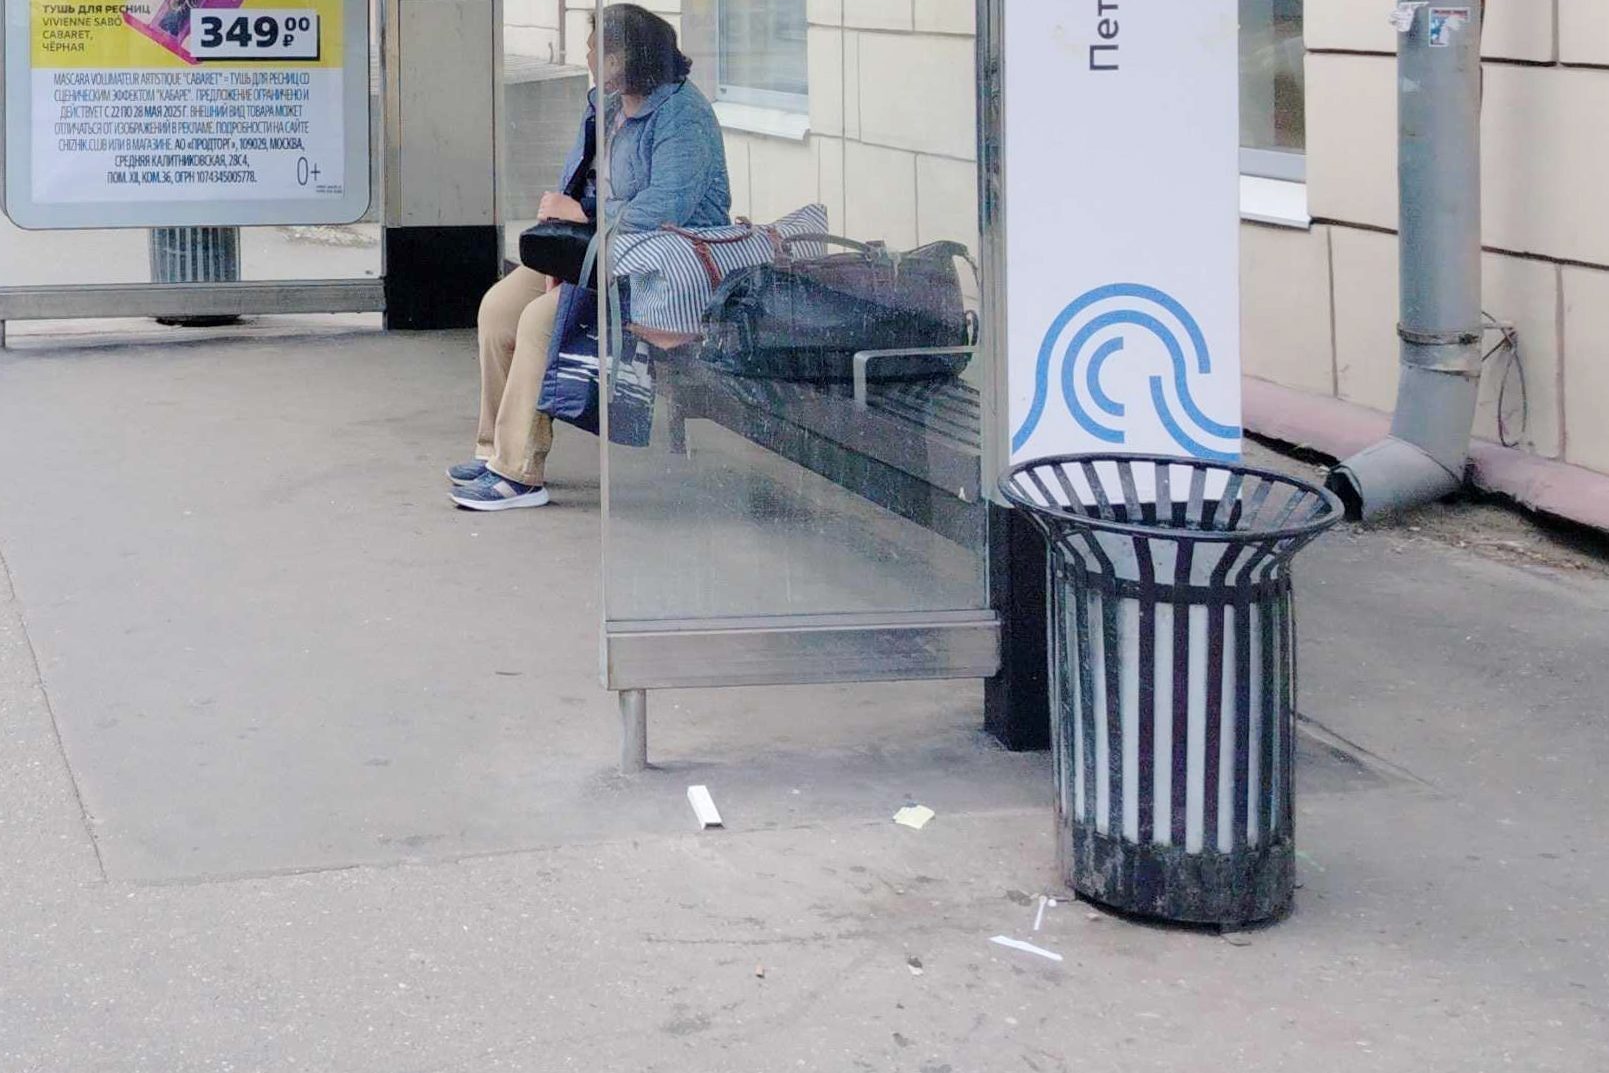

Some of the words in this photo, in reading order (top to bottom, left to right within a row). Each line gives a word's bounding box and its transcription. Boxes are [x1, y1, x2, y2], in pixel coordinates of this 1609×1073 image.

[42, 4, 75, 14] ТУШЬ
[77, 4, 103, 15] ДЛЯ
[105, 4, 151, 15] РЕСНИЦ
[42, 17, 92, 27] VIVIENNE
[42, 30, 93, 40] CABARET,
[200, 15, 280, 48] 349
[284, 16, 310, 32] 00
[42, 41, 85, 52] ЧЁРНАЯ
[54, 73, 90, 86] MASCARA
[196, 88, 252, 103] ПРЕДЛОЖЕНИЕ
[144, 106, 162, 118] МАЯ
[296, 156, 321, 186] 0+
